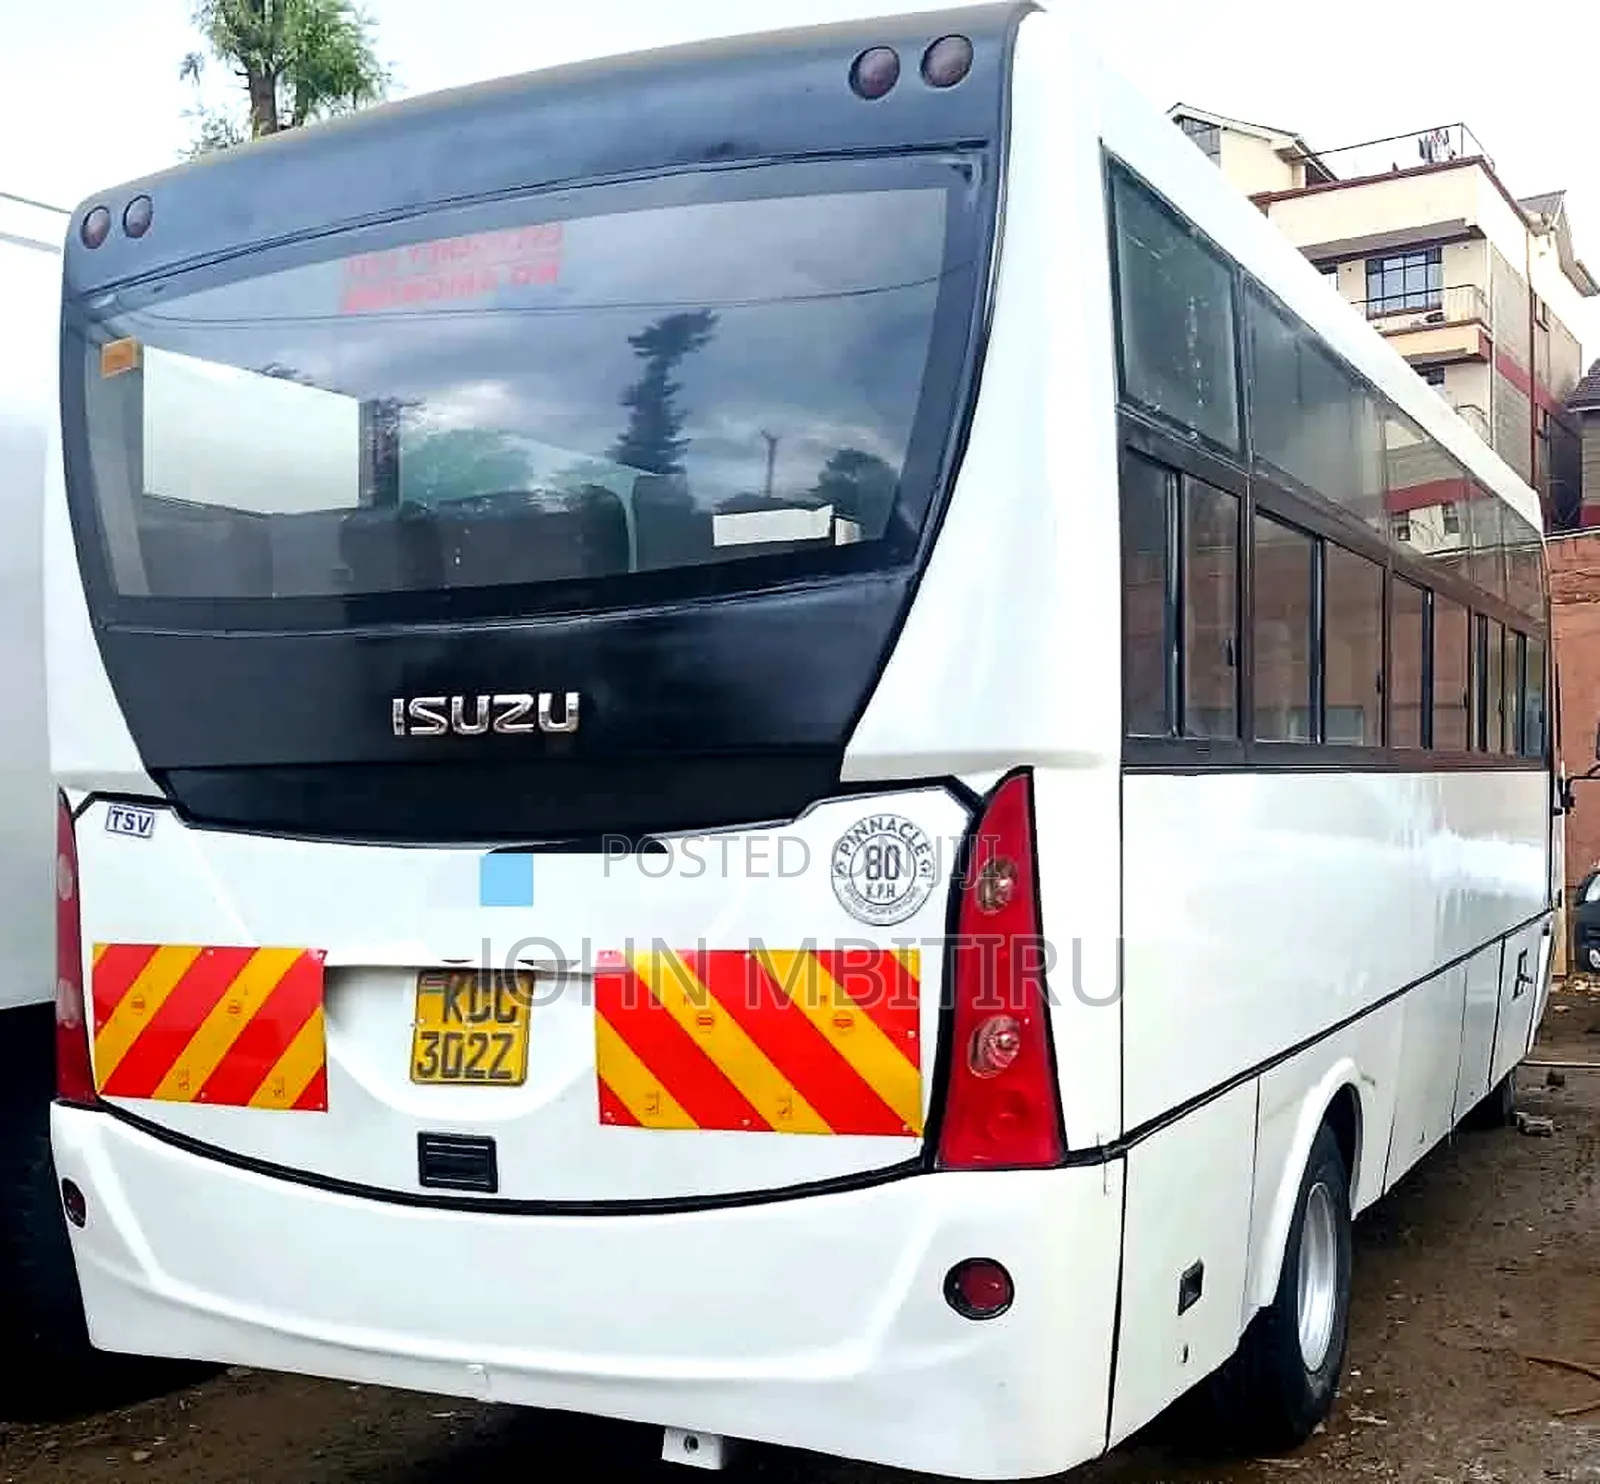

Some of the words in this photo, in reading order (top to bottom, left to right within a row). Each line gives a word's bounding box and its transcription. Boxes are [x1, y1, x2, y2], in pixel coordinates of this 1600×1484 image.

[392, 692, 580, 736] ISUZU
[112, 809, 152, 833] TSV
[838, 817, 931, 858] PINNACLE
[865, 844, 901, 881] 80
[442, 969, 518, 1024] KDC
[416, 1030, 516, 1079] 302Z
